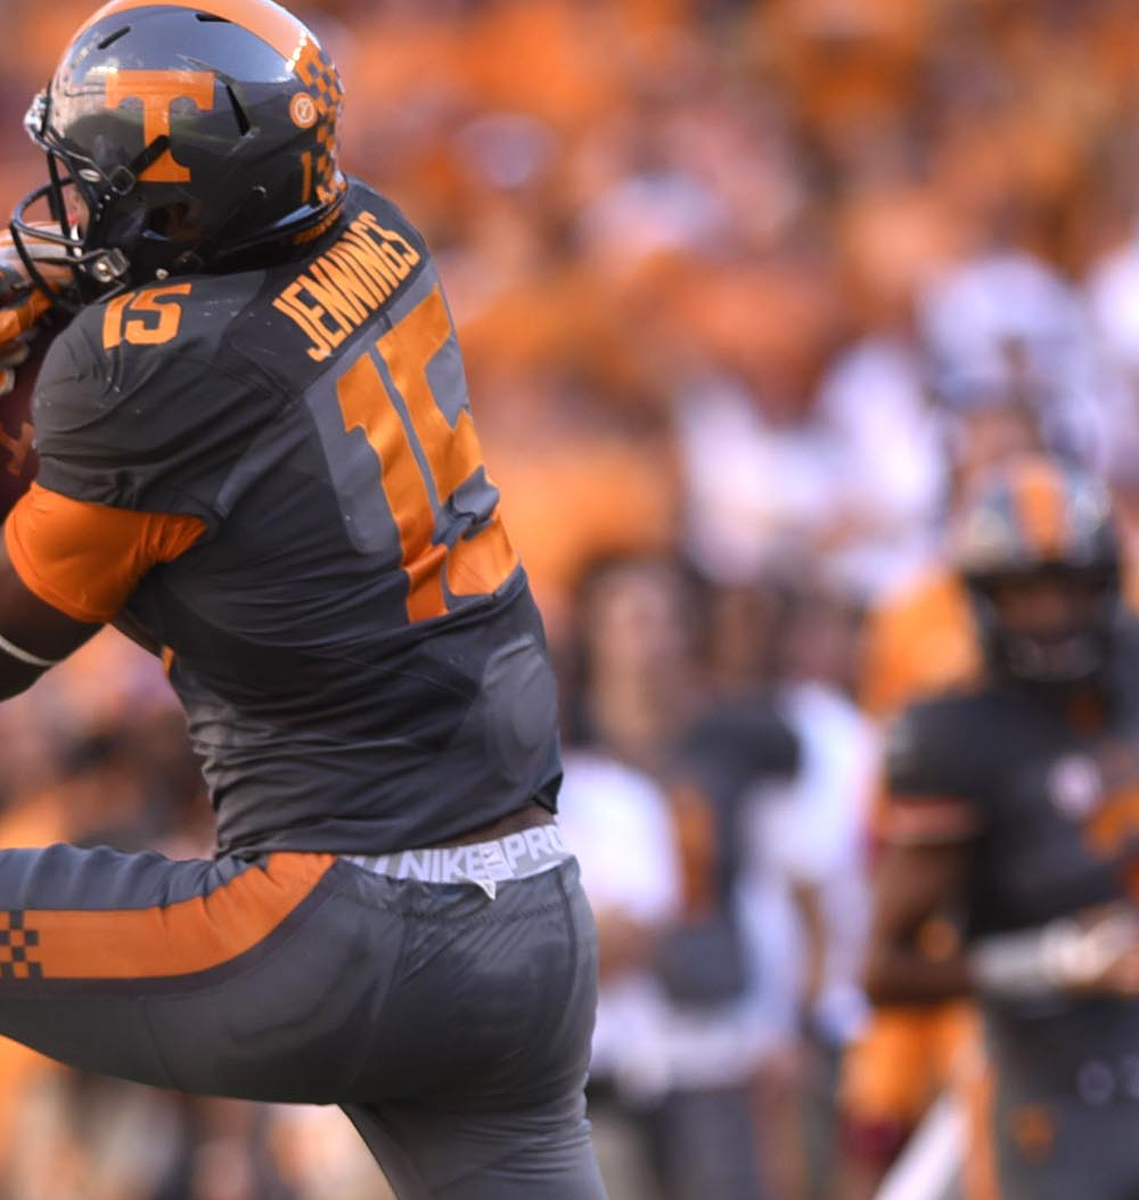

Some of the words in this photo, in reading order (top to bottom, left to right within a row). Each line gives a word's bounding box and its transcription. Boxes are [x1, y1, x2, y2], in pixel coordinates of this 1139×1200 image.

[102, 283, 191, 349] 15
[272, 210, 421, 362] JENNINGS
[336, 284, 522, 623] 15
